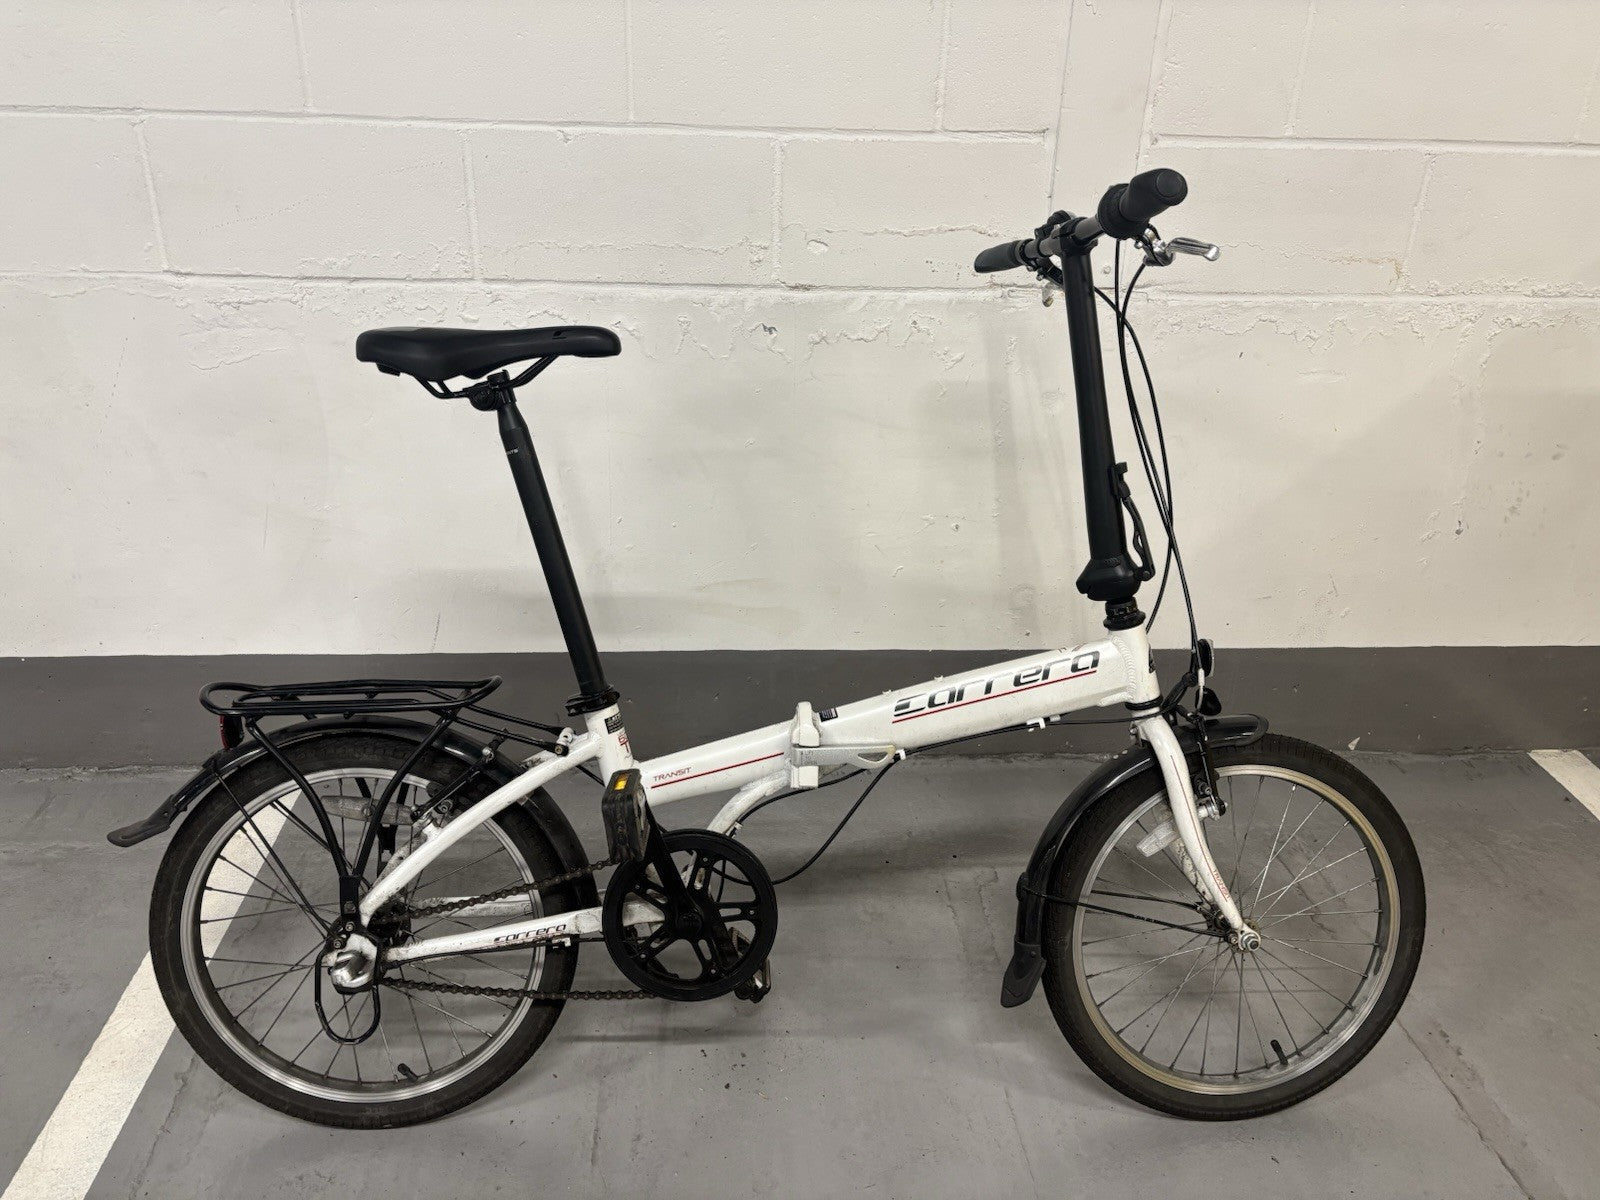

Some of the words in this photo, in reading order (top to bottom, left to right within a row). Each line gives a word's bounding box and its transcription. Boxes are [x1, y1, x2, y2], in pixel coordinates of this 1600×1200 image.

[894, 651, 1100, 717] carrera
[653, 767, 692, 782] TRANSIT
[494, 924, 566, 943] carrera
